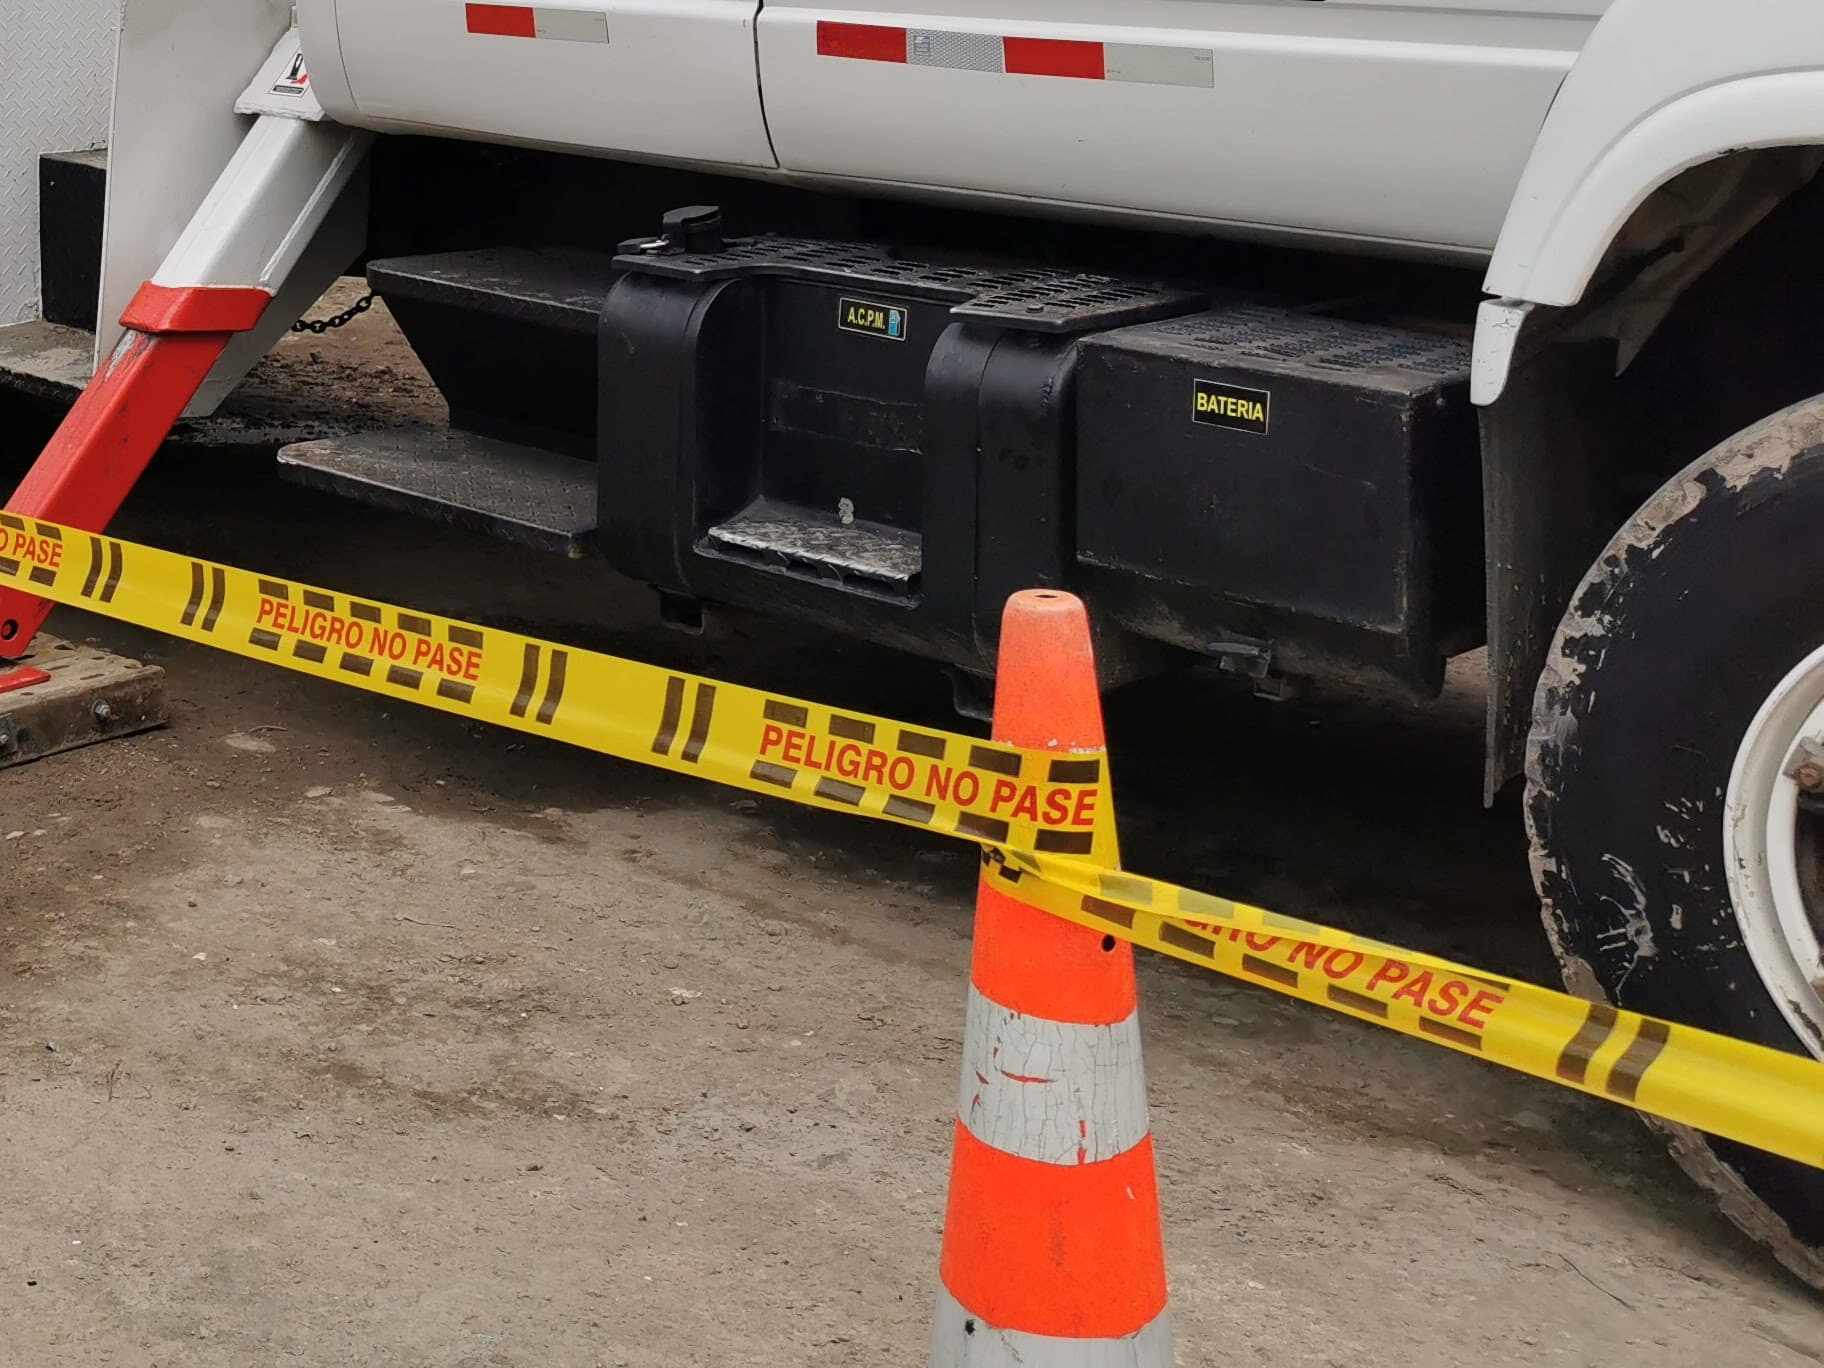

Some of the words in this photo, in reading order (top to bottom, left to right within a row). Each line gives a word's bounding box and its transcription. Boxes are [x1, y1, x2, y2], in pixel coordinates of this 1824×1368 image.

[847, 306, 886, 330] A.C.P.M.
[1196, 391, 1265, 422] BATERIA
[12, 533, 64, 568] PASE
[256, 597, 364, 649] PELIGRO
[368, 627, 407, 660] NO
[412, 638, 483, 681] PASE
[759, 724, 915, 791] PELIGRO
[925, 764, 980, 806] NO
[990, 779, 1098, 827] PASE
[1287, 940, 1364, 980] NO
[1366, 959, 1504, 1029] PASE
